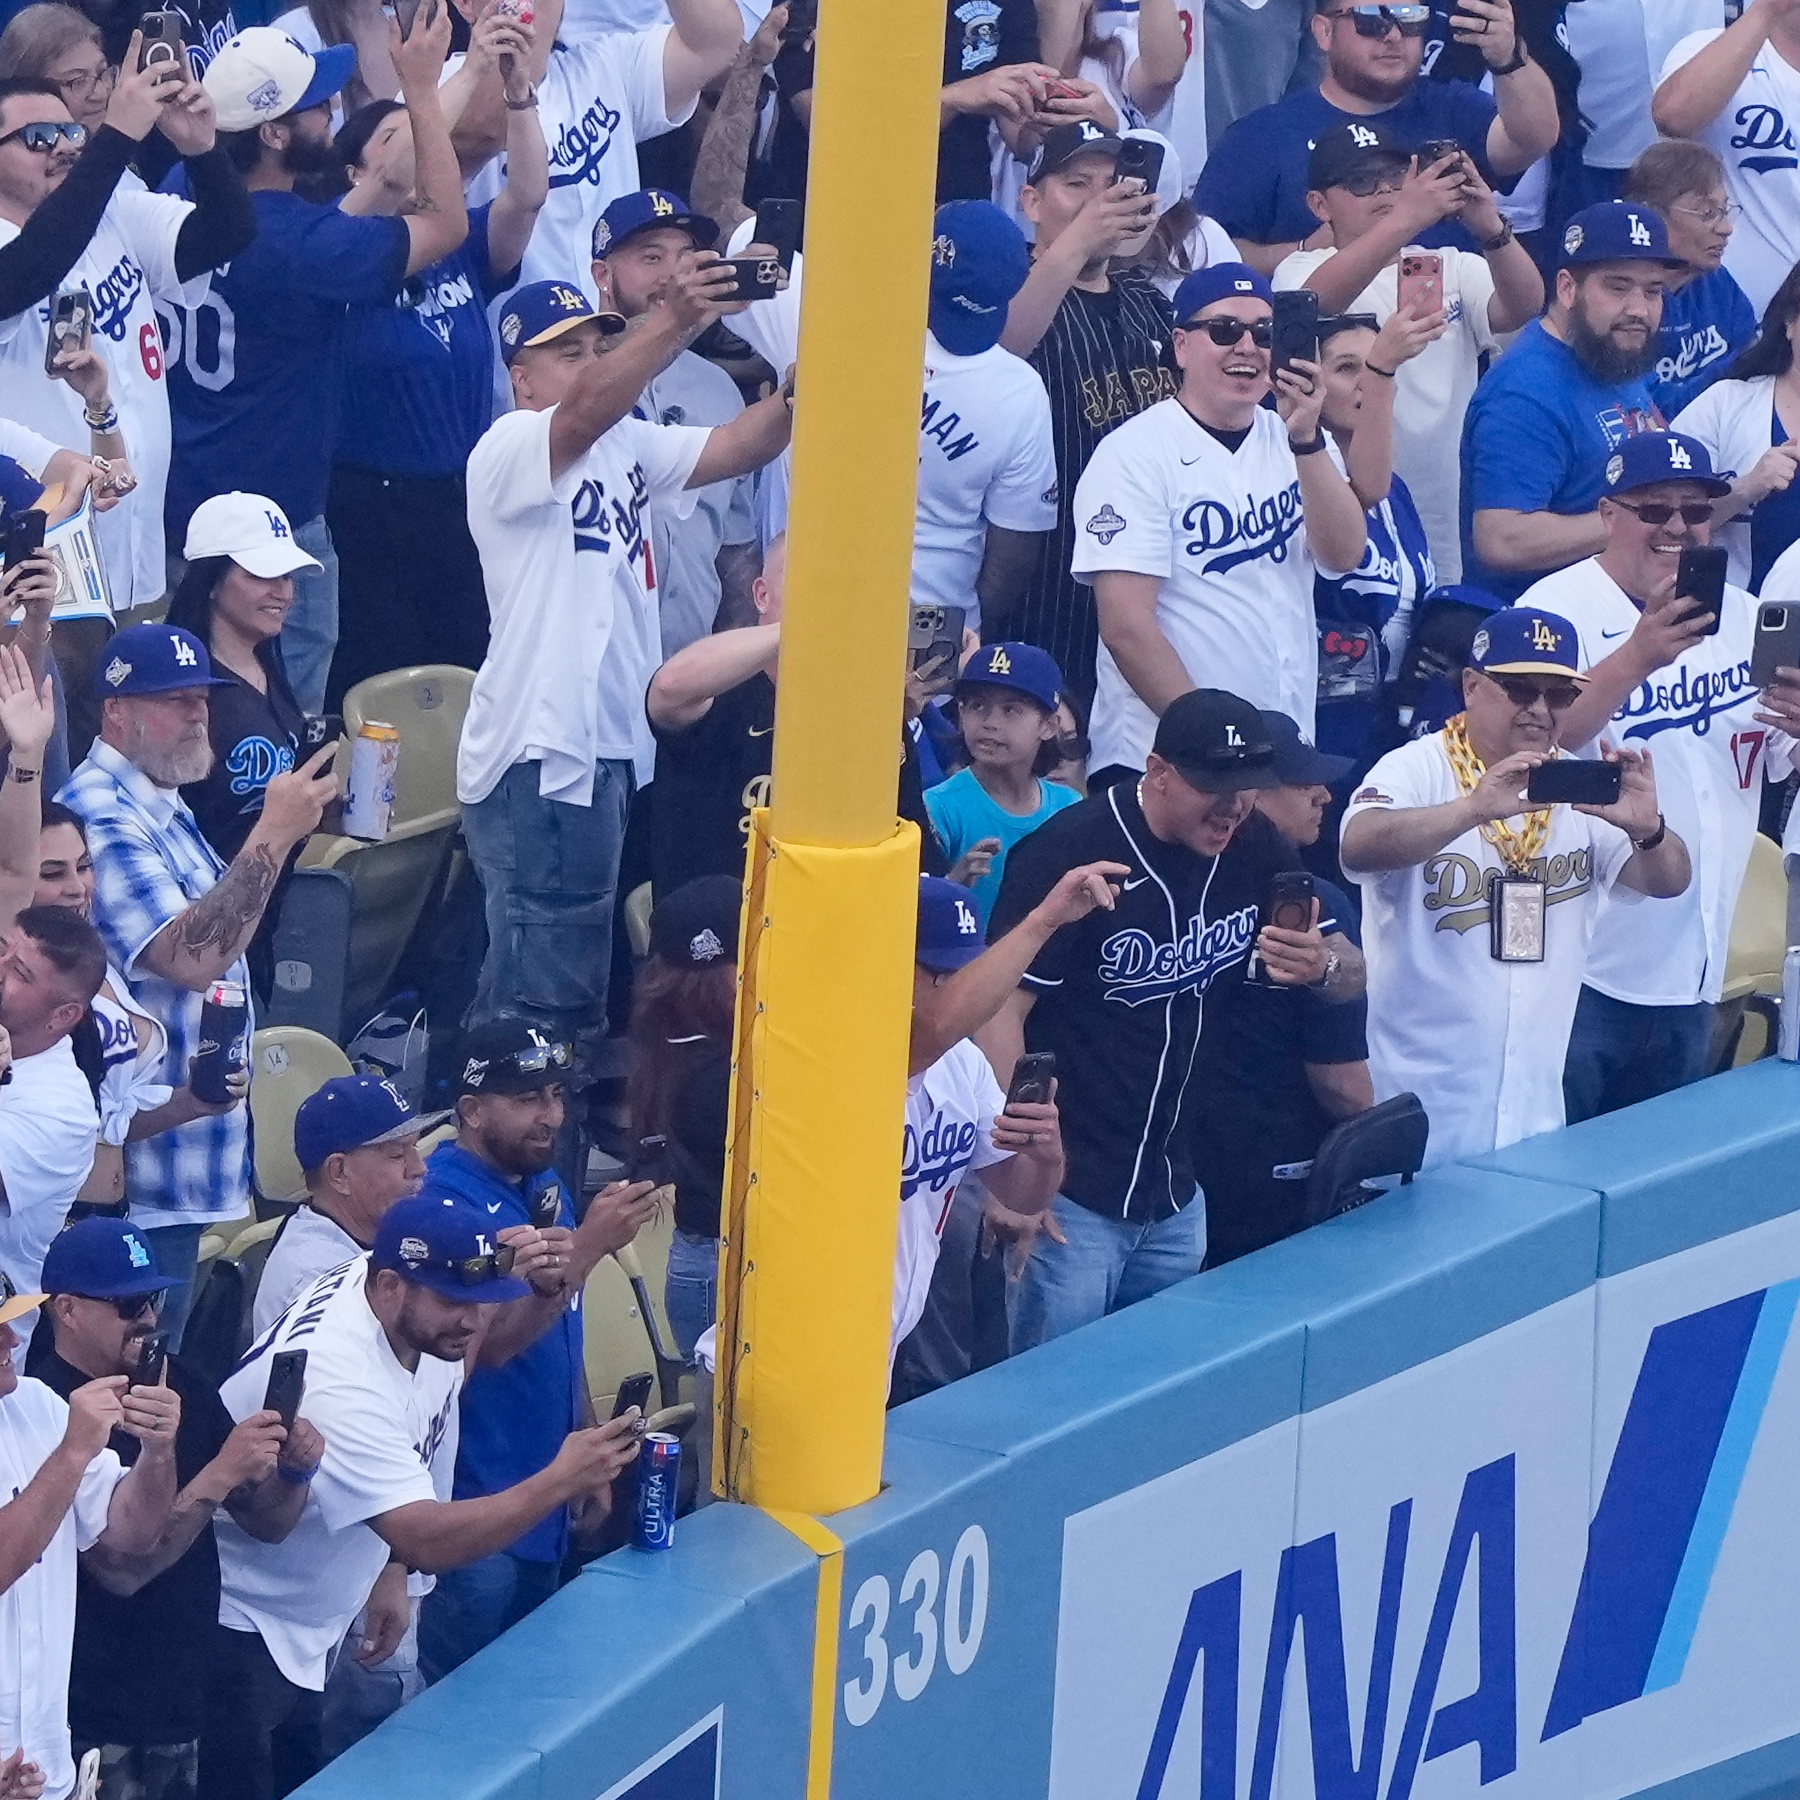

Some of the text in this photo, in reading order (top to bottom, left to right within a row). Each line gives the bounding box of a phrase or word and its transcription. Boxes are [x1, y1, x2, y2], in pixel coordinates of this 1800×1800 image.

[1347, 124, 1379, 148] LA
[648, 192, 673, 216] LA
[1628, 215, 1651, 246] LA
[550, 286, 584, 311] LA
[1084, 367, 1178, 428] JAPA
[1668, 439, 1692, 470] LA
[264, 510, 288, 538] LA
[170, 635, 197, 666] LA
[1532, 618, 1557, 652] LA
[989, 646, 1011, 675] LA
[1731, 730, 1766, 790] 17
[955, 901, 977, 933] LA
[1099, 906, 1260, 997] Dodgers
[123, 1234, 150, 1268] LA
[644, 1473, 663, 1535] ULTRA
[844, 1524, 991, 1726] 330
